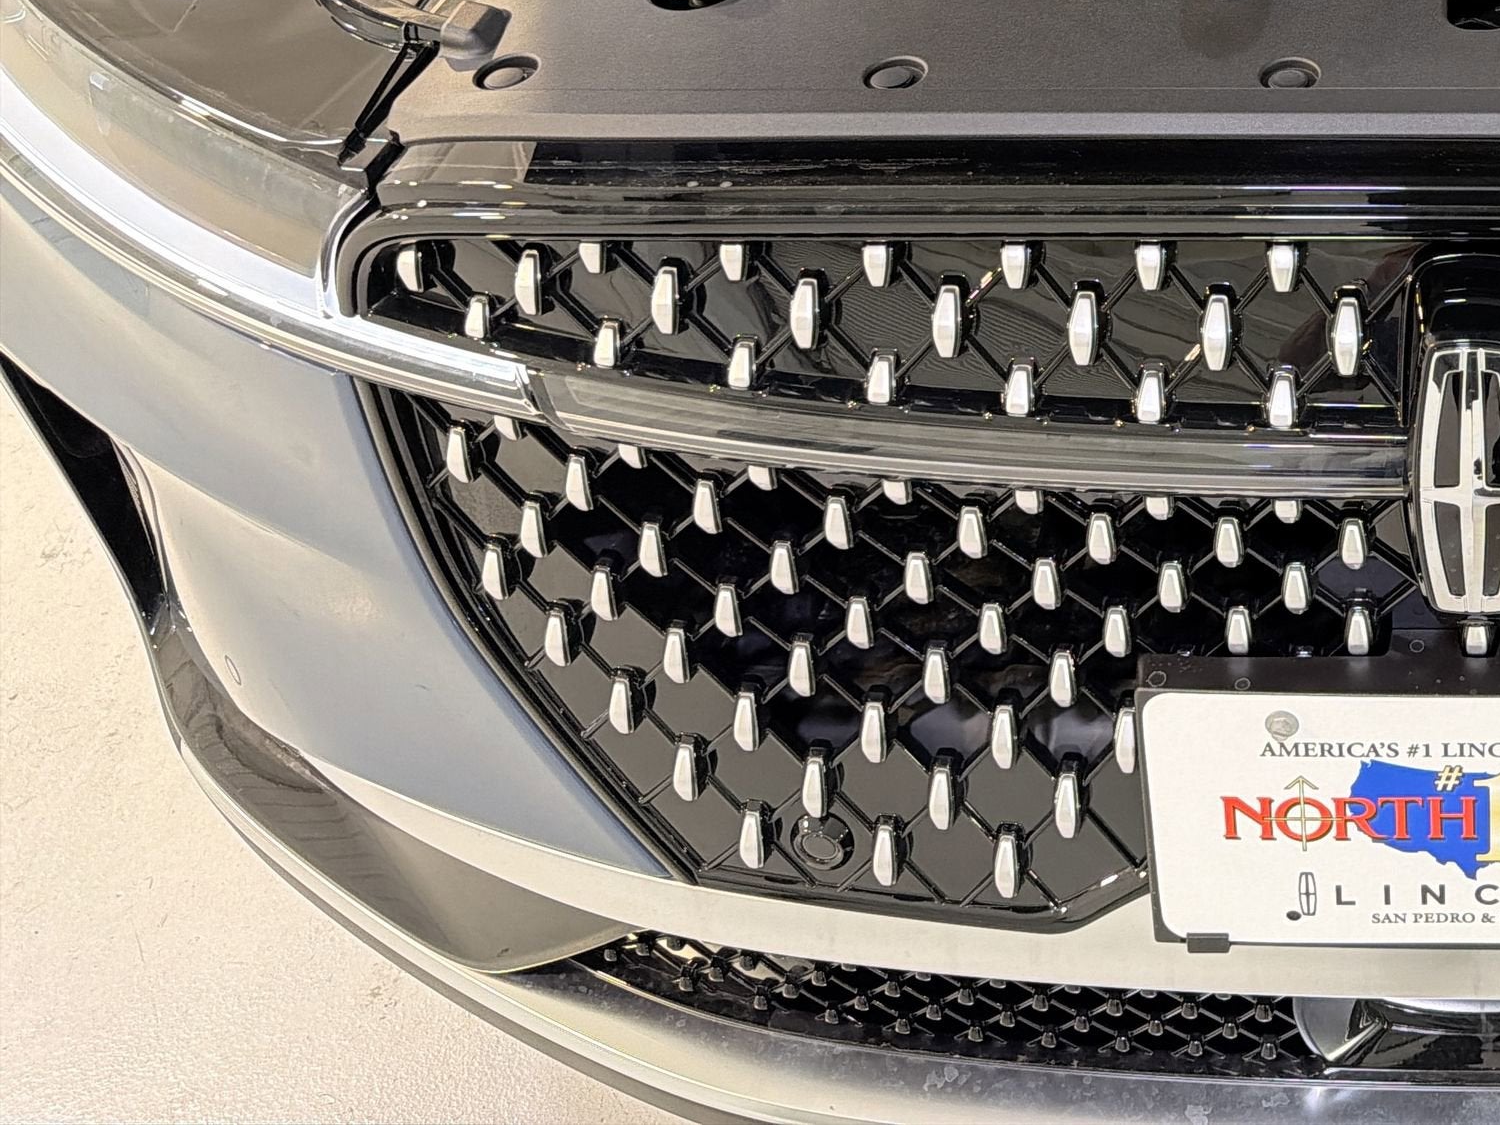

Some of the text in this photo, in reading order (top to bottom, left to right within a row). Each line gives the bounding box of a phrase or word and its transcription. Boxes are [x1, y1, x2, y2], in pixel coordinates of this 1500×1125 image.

[1260, 741, 1400, 758] AMERICA'S
[1406, 742, 1433, 758] #1
[1221, 795, 1479, 842] NORTH
[1371, 912, 1407, 925] SAN
[1413, 912, 1476, 925] PEDRO
[1481, 912, 1497, 924] &
